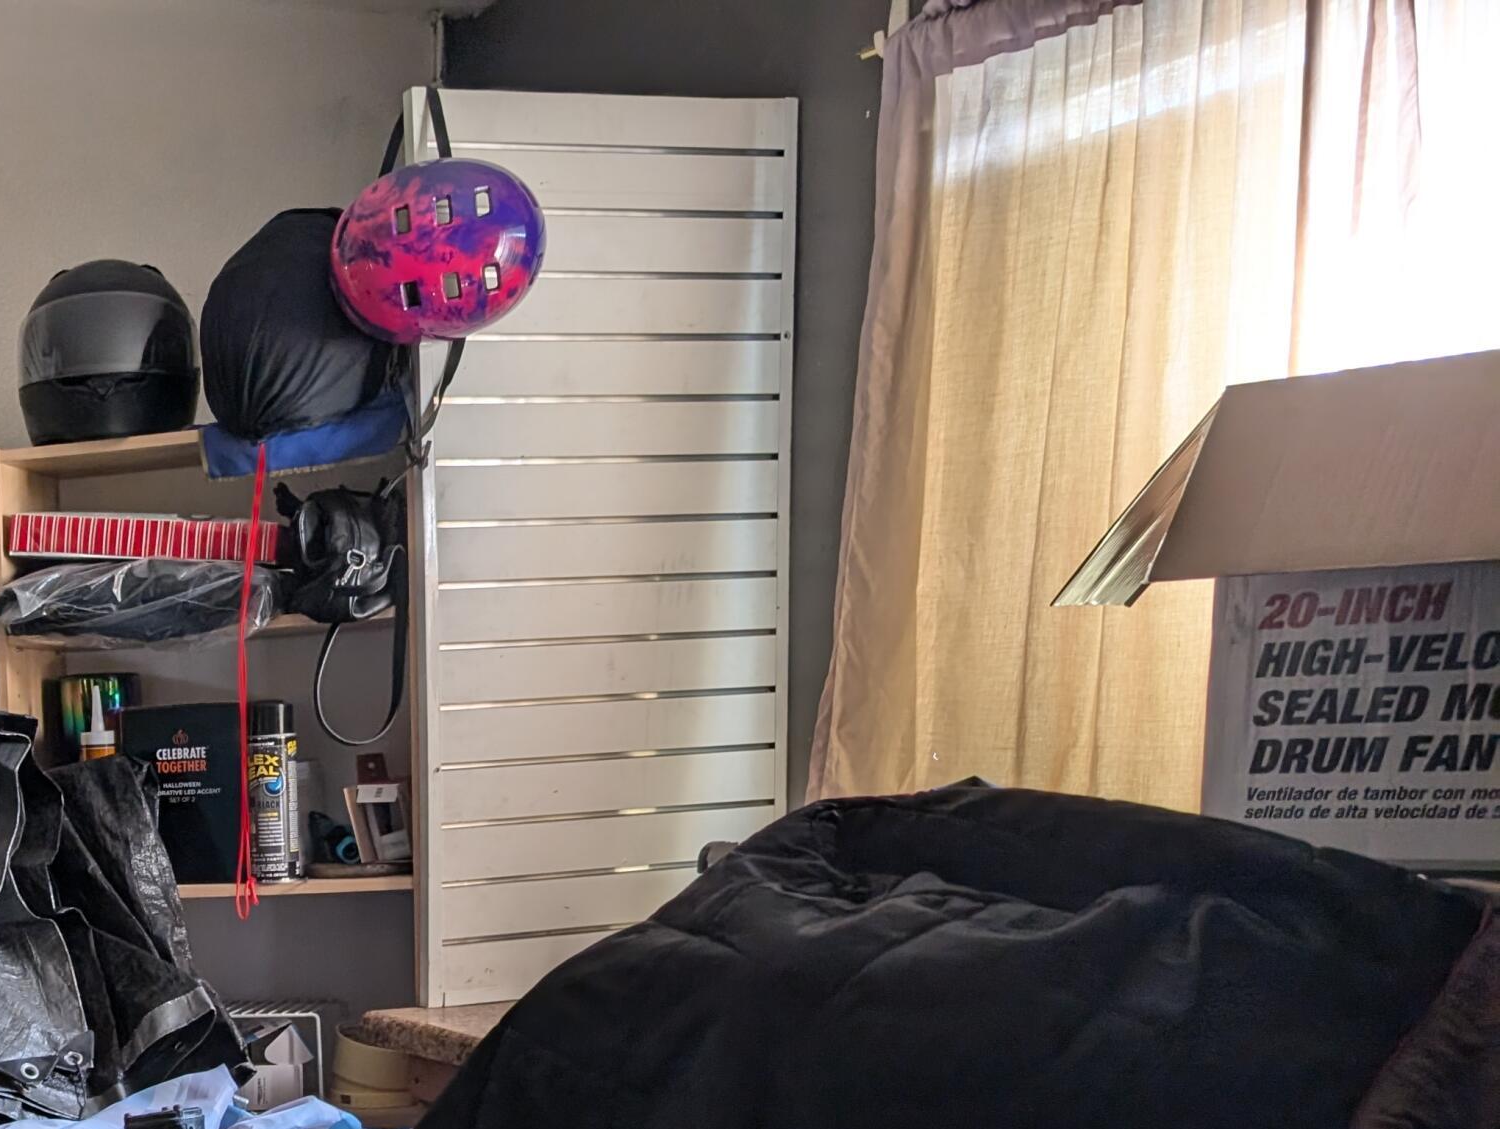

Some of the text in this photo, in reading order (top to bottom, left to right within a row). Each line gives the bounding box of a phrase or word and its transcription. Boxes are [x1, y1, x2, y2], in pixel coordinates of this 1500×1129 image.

[1258, 581, 1454, 631] 20-INCH
[1252, 685, 1430, 728] SEALED
[156, 746, 207, 760] CELEBRATE
[1249, 733, 1500, 774] DRUM FAN
[156, 760, 207, 773] TOGETHER
[248, 765, 280, 780] EAL
[162, 781, 202, 789] HALLOWEEN
[196, 787, 221, 795] ACCENT
[1247, 786, 1333, 802] Ventilador
[1337, 786, 1358, 801] de
[1363, 786, 1428, 801] tambor
[1432, 788, 1465, 800] con
[1244, 804, 1304, 819] sellado
[1308, 805, 1330, 819] de
[1335, 804, 1368, 818] alta
[1374, 804, 1460, 818] velocidad
[1464, 805, 1486, 818] de
